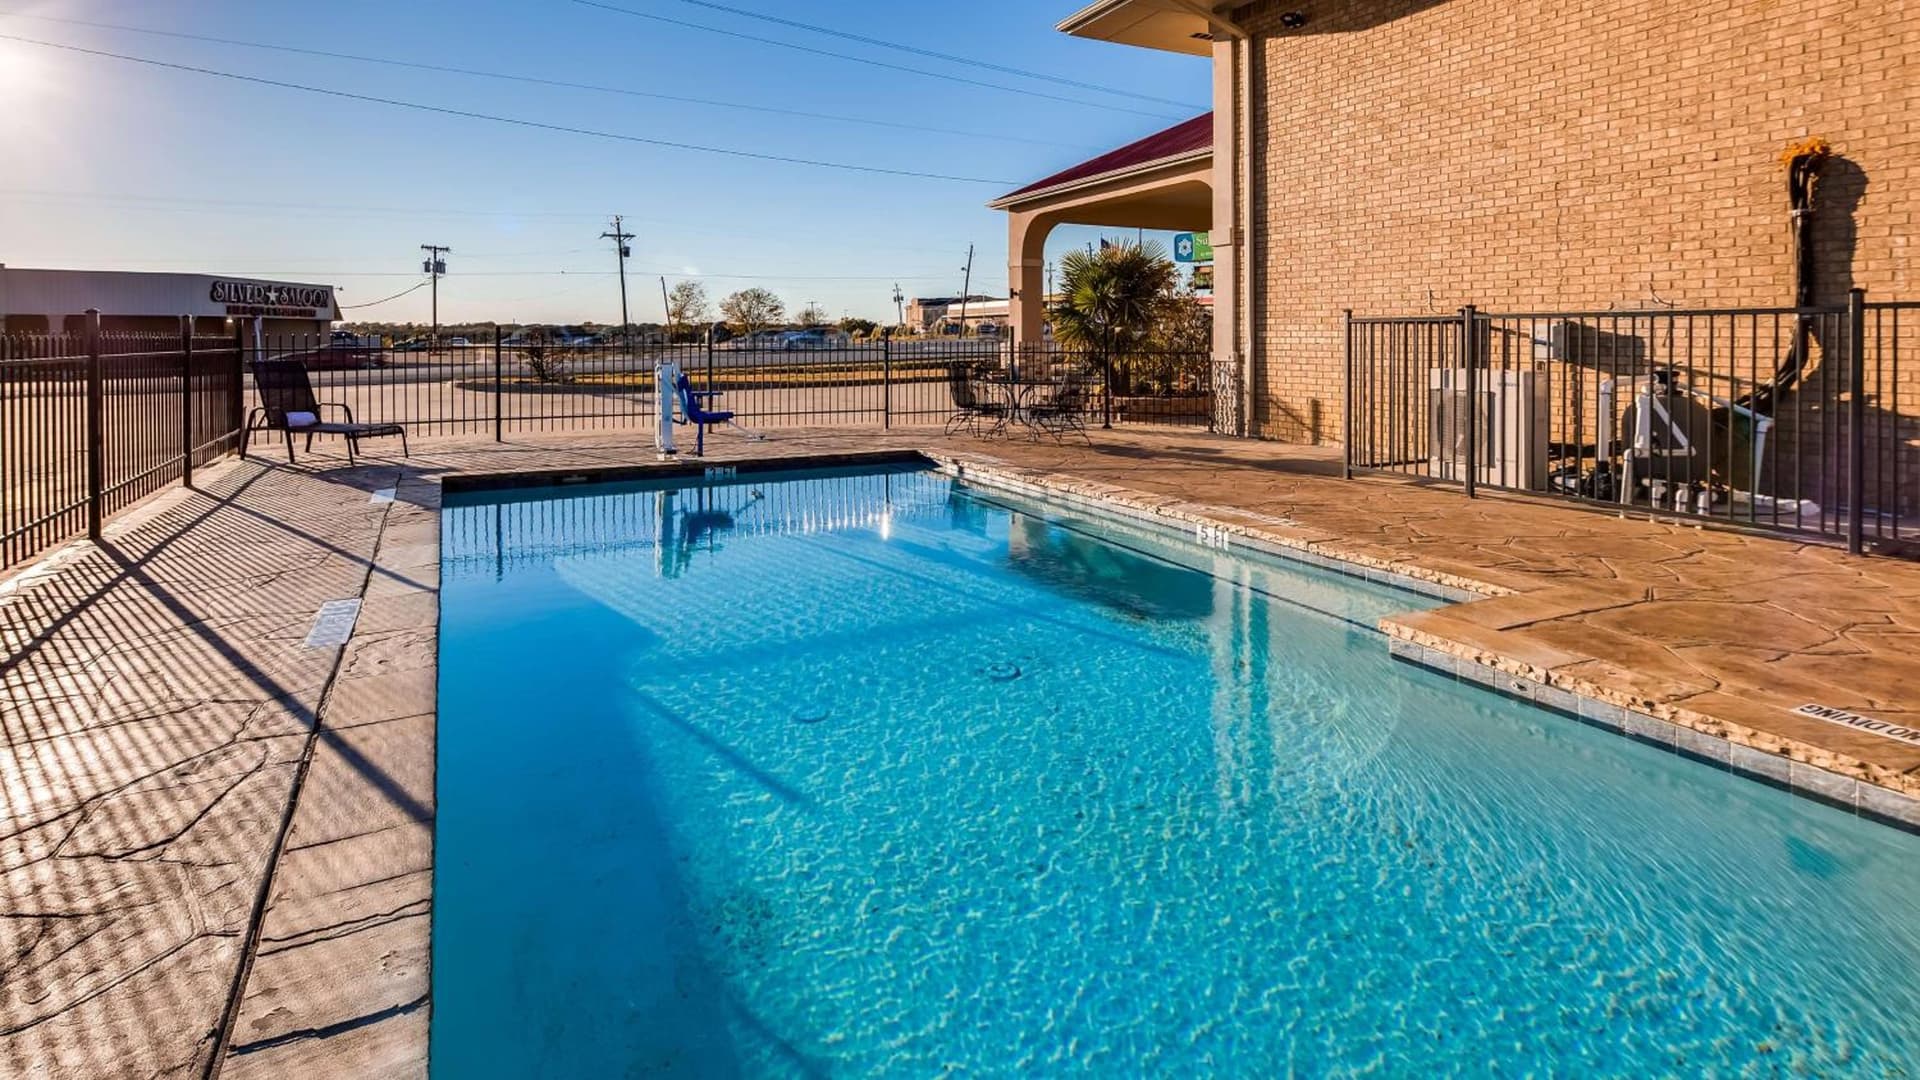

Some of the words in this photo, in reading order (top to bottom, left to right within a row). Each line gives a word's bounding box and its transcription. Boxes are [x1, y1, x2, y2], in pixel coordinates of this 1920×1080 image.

[212, 280, 265, 303] SILVER
[280, 286, 329, 308] SALOON
[1800, 704, 1889, 730] DIVING
[1886, 727, 1920, 740] NO
